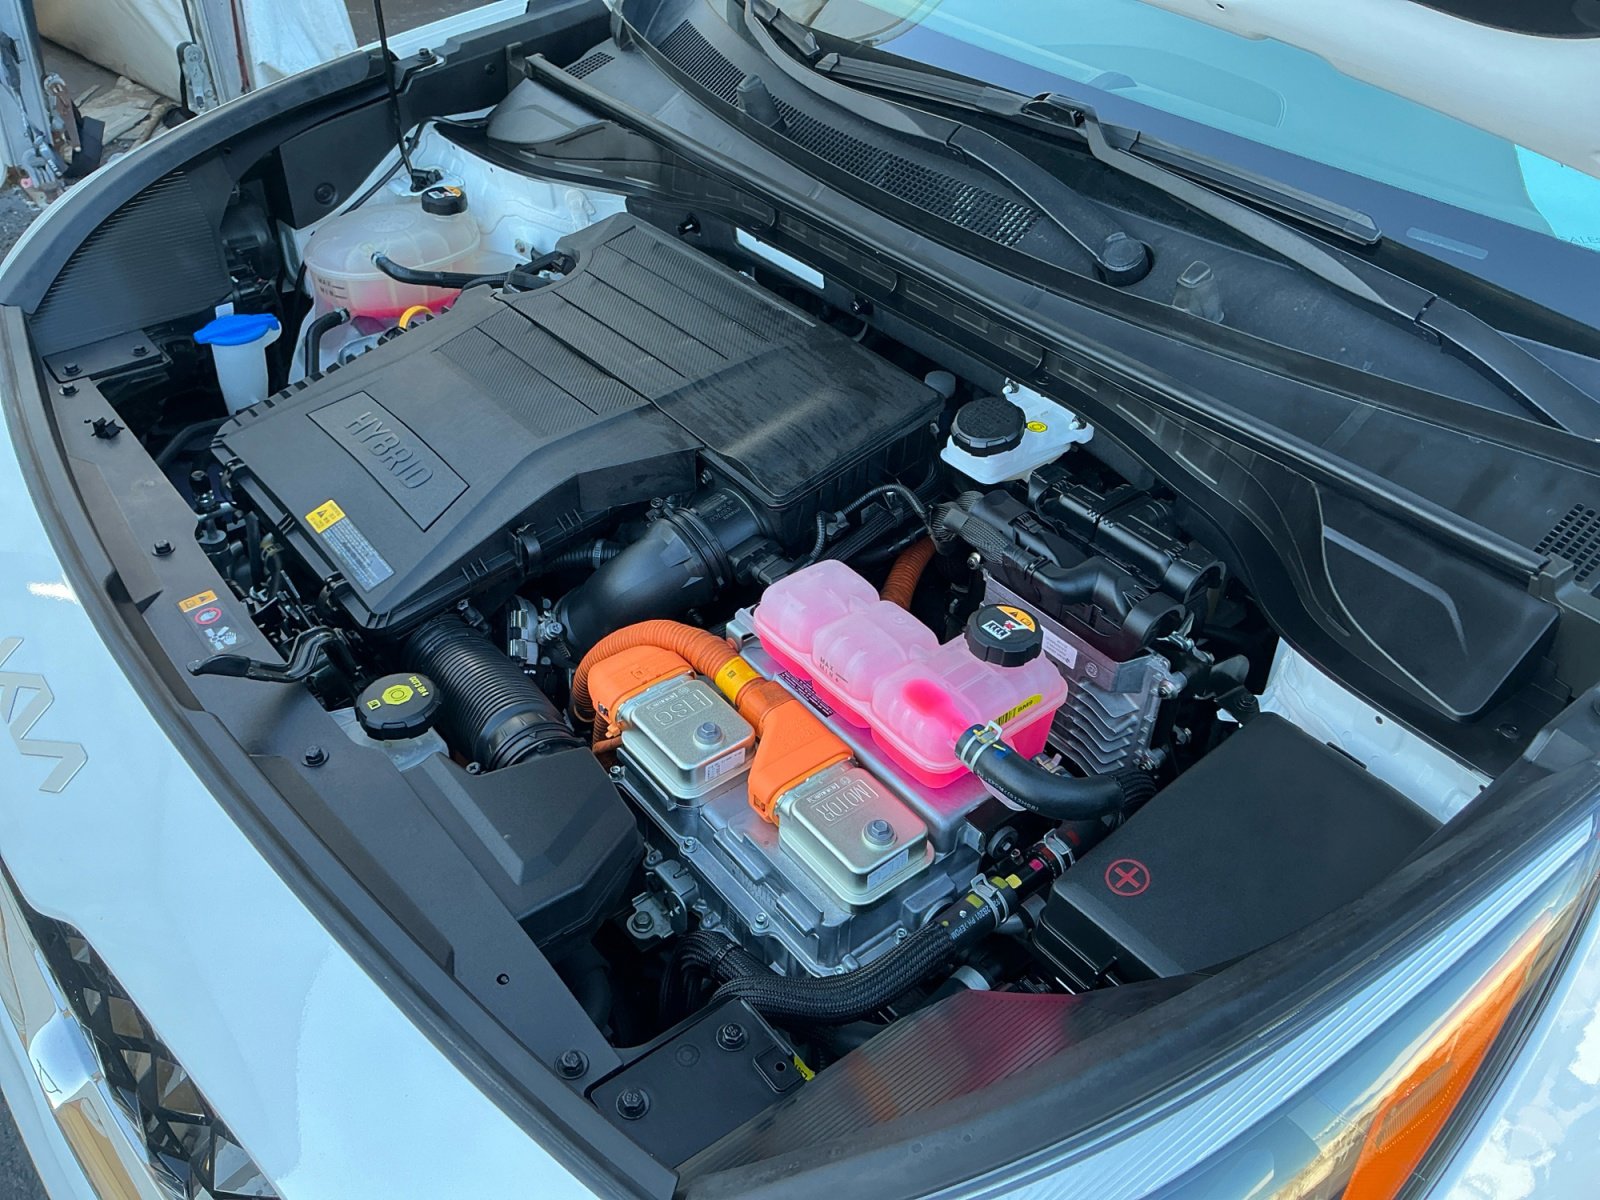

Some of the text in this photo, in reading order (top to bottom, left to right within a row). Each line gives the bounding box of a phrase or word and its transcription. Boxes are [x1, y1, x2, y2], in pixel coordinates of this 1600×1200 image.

[344, 411, 434, 489] HYBRID
[654, 692, 706, 726] HSG
[815, 784, 872, 822] MOTOR
